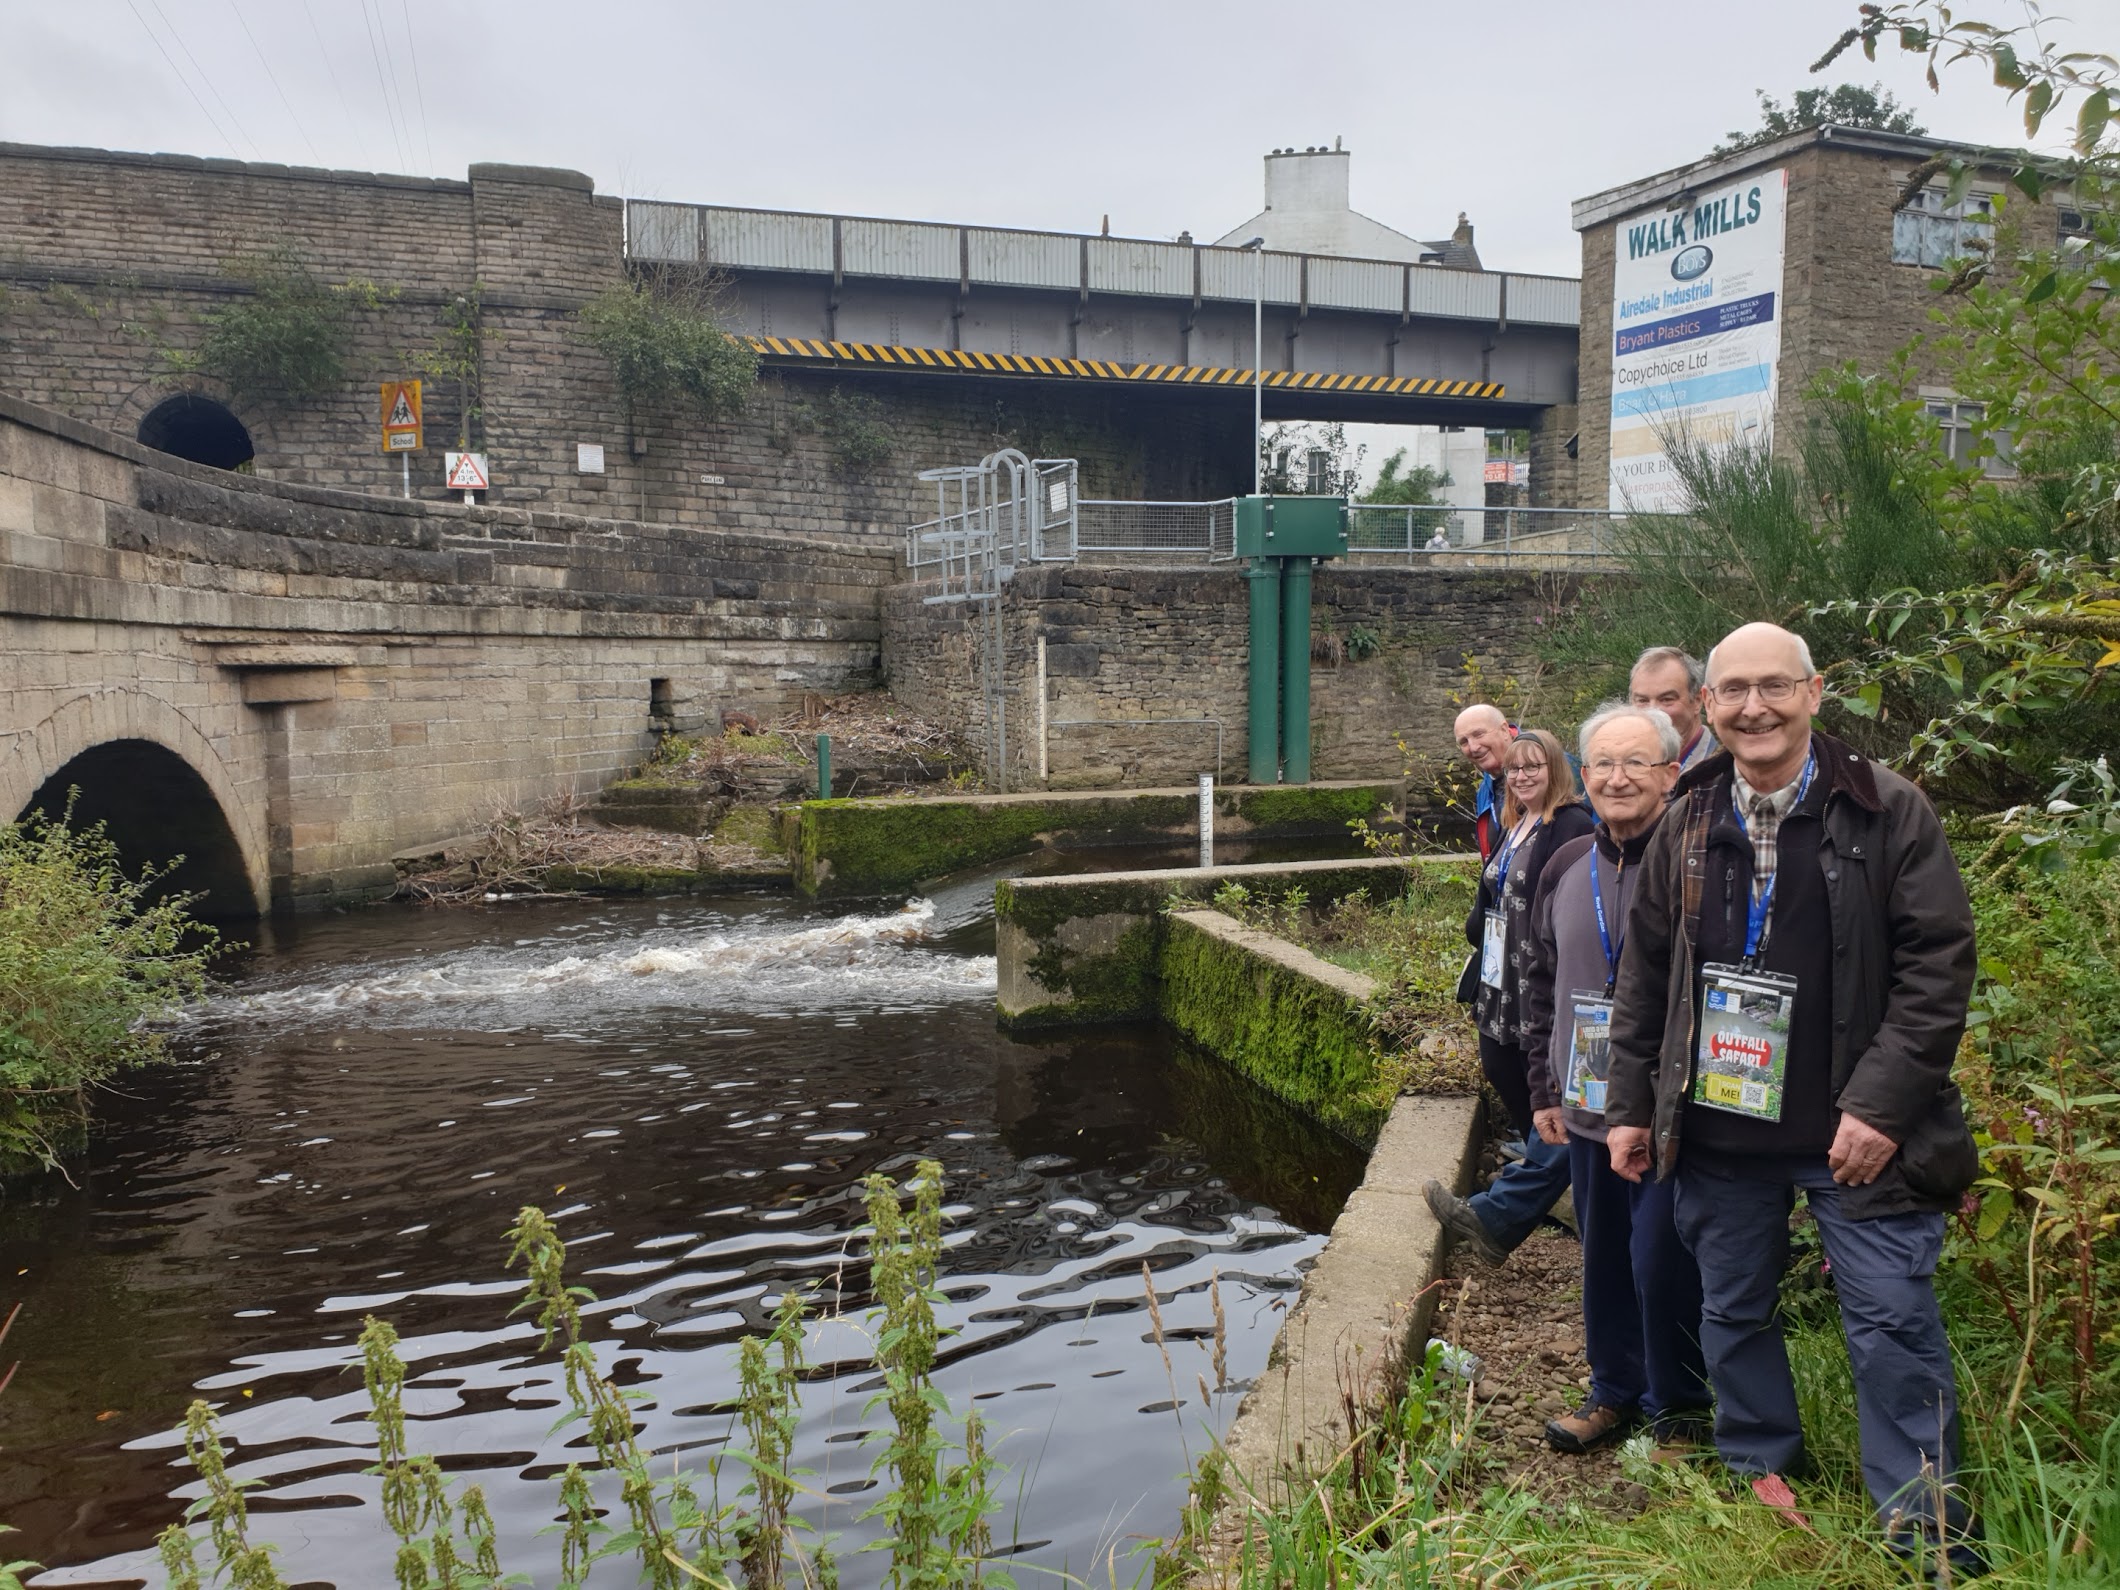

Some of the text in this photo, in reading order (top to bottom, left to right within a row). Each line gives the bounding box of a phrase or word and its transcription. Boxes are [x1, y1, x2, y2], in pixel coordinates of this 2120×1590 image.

[1628, 187, 1761, 260] WALK MILLS
[1620, 277, 1713, 319] Airedale Industrial
[1619, 330, 1655, 351] Bryant
[1658, 321, 1700, 340] Plastics
[1618, 359, 1684, 385] Copychoice
[1688, 351, 1708, 370] Ltd
[1618, 390, 1687, 411] Brian O'Hara
[1691, 414, 1734, 434] TORE
[393, 437, 413, 446] School
[1623, 461, 1655, 477] YOUR
[1597, 909, 1605, 932] Guardian
[1717, 1030, 1767, 1053] OUTFALL
[1719, 1048, 1762, 1068] SAFARI
[1720, 1087, 1740, 1100] ME!
[1721, 1080, 1740, 1091] SCAN
